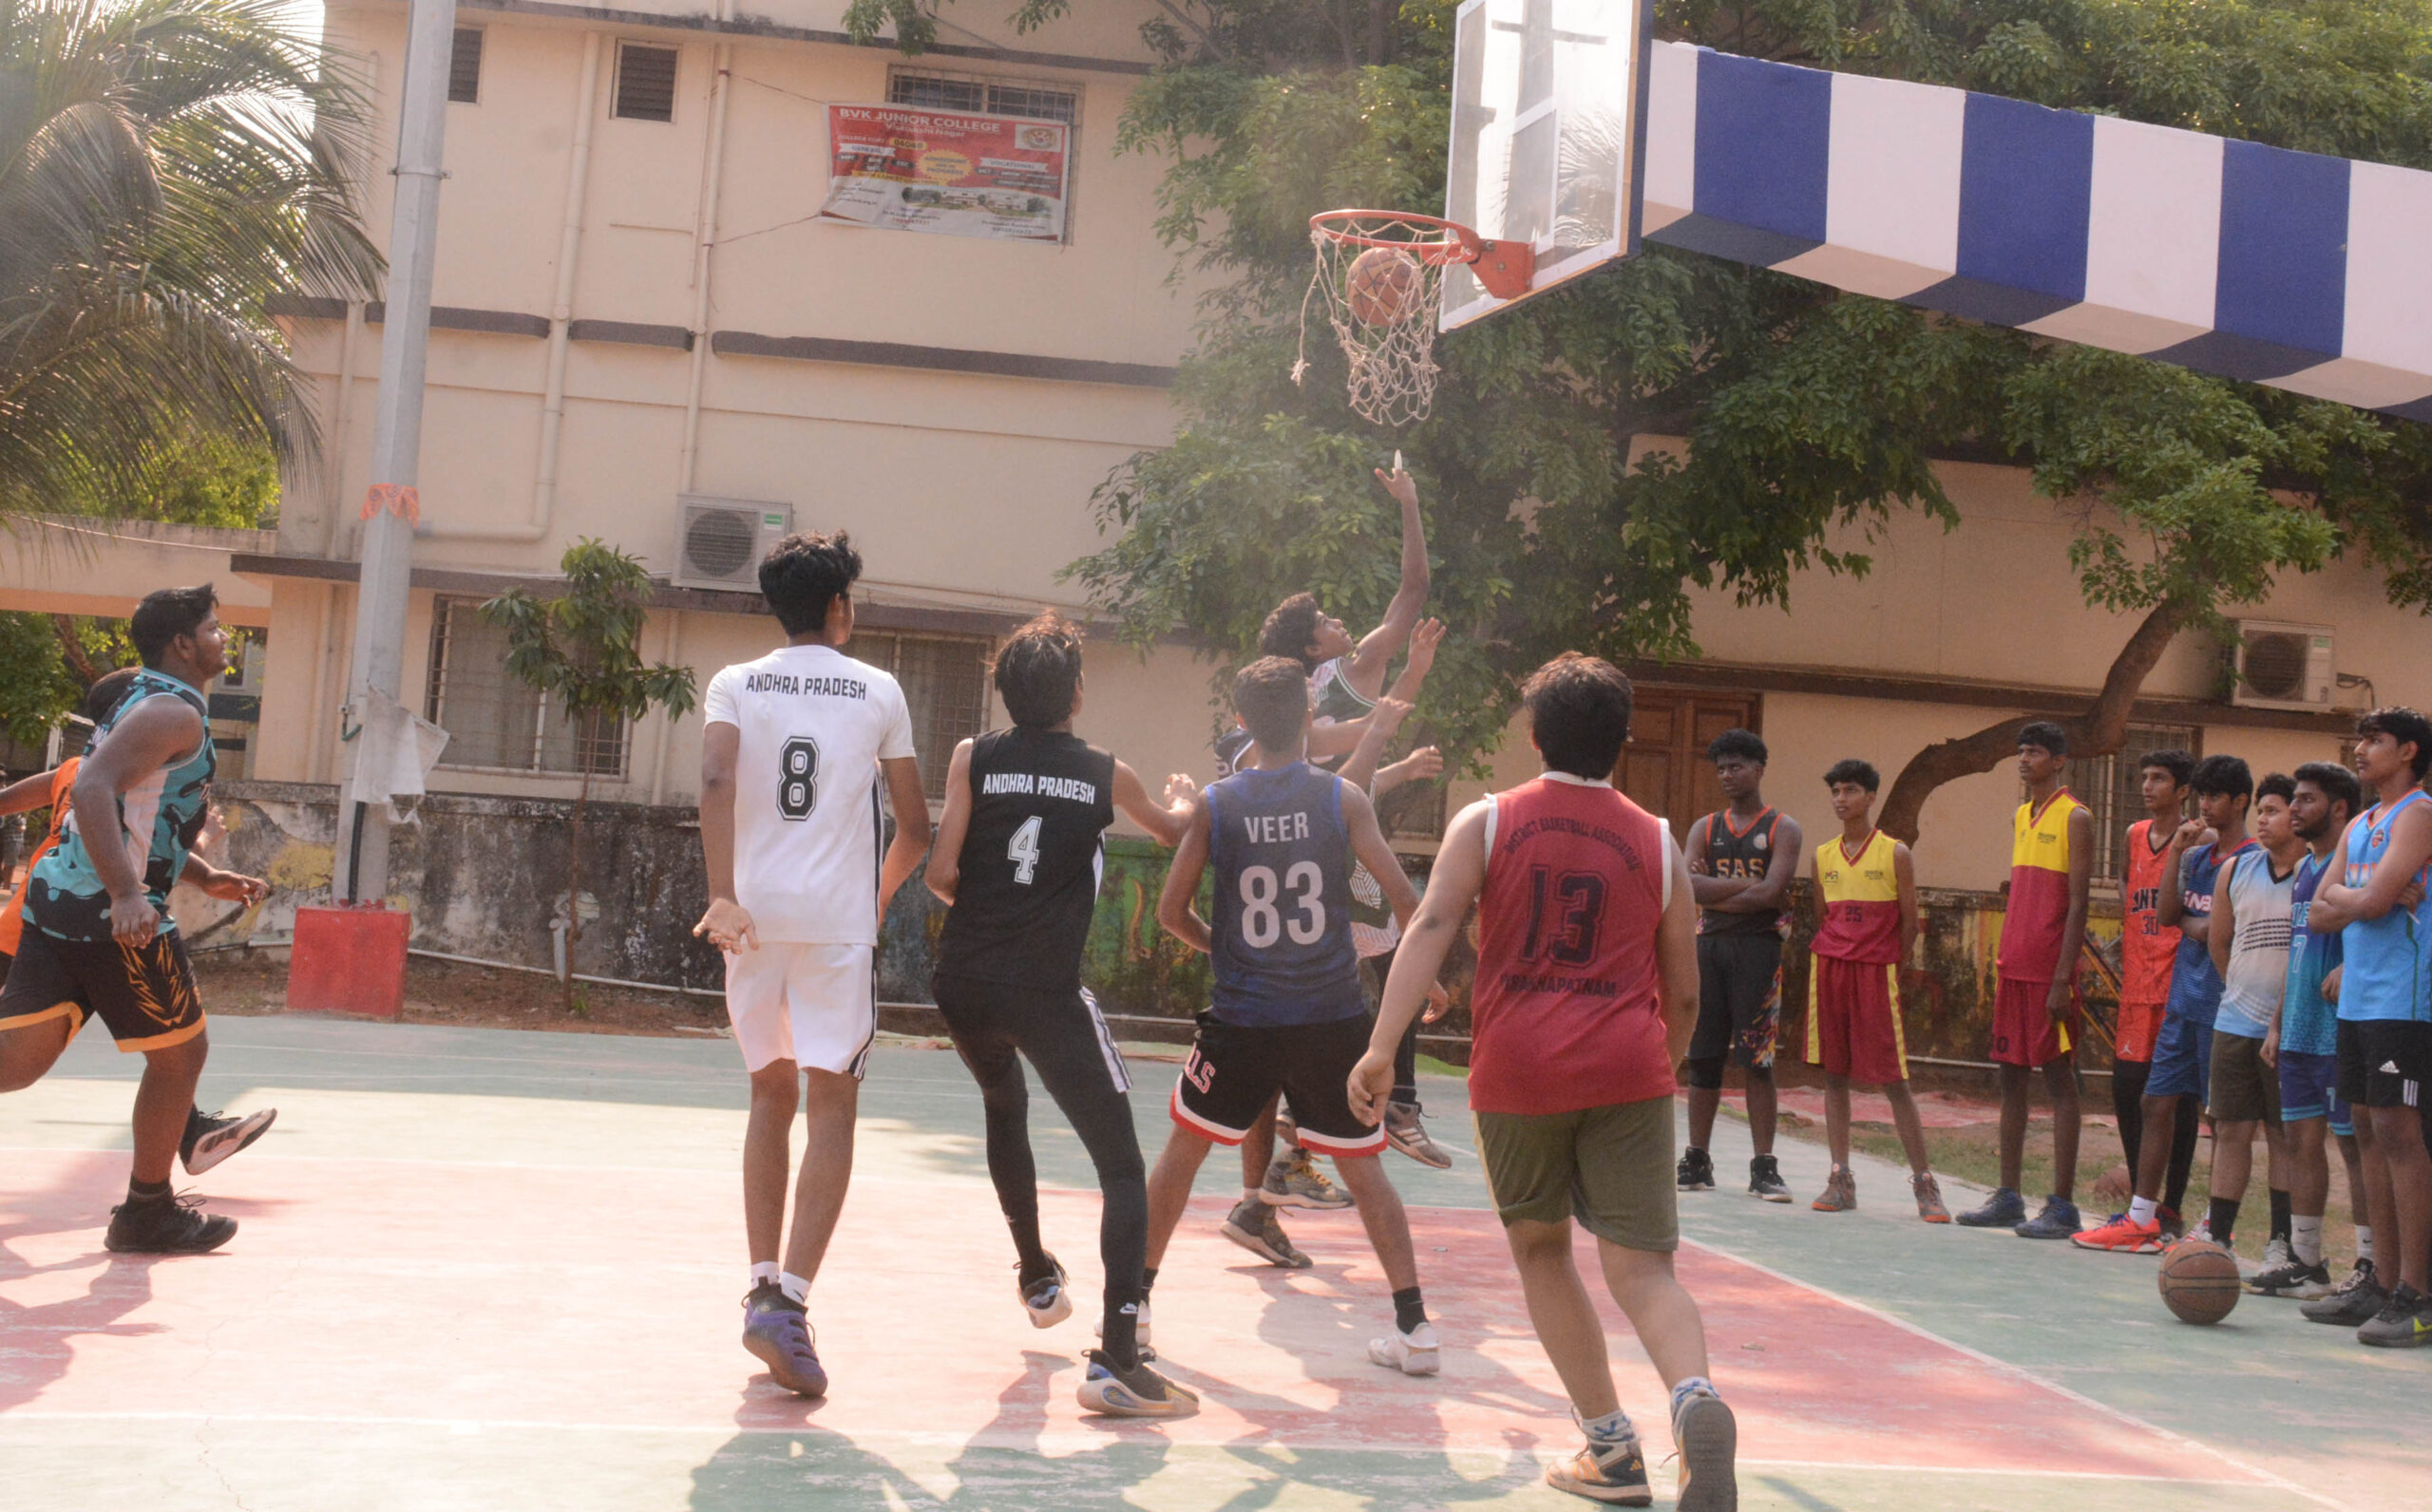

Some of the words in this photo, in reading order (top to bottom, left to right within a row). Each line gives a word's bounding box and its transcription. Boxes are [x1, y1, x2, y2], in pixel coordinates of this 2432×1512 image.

[839, 107, 871, 120] BVK
[876, 111, 930, 125] JUNIOR
[933, 117, 1000, 132] COLLEGE
[746, 673, 799, 695] ANDHRA
[804, 677, 866, 700] PRADESH
[776, 735, 820, 822] 8
[982, 773, 1034, 795] ANDHRA
[1036, 775, 1095, 804] PRADESH
[1244, 811, 1309, 843] VEER
[1504, 821, 1539, 854] DISTRICT
[1007, 815, 1042, 885] 4
[1239, 860, 1326, 949] 83
[1519, 863, 1610, 970] 13
[2291, 935, 2308, 973] 7
